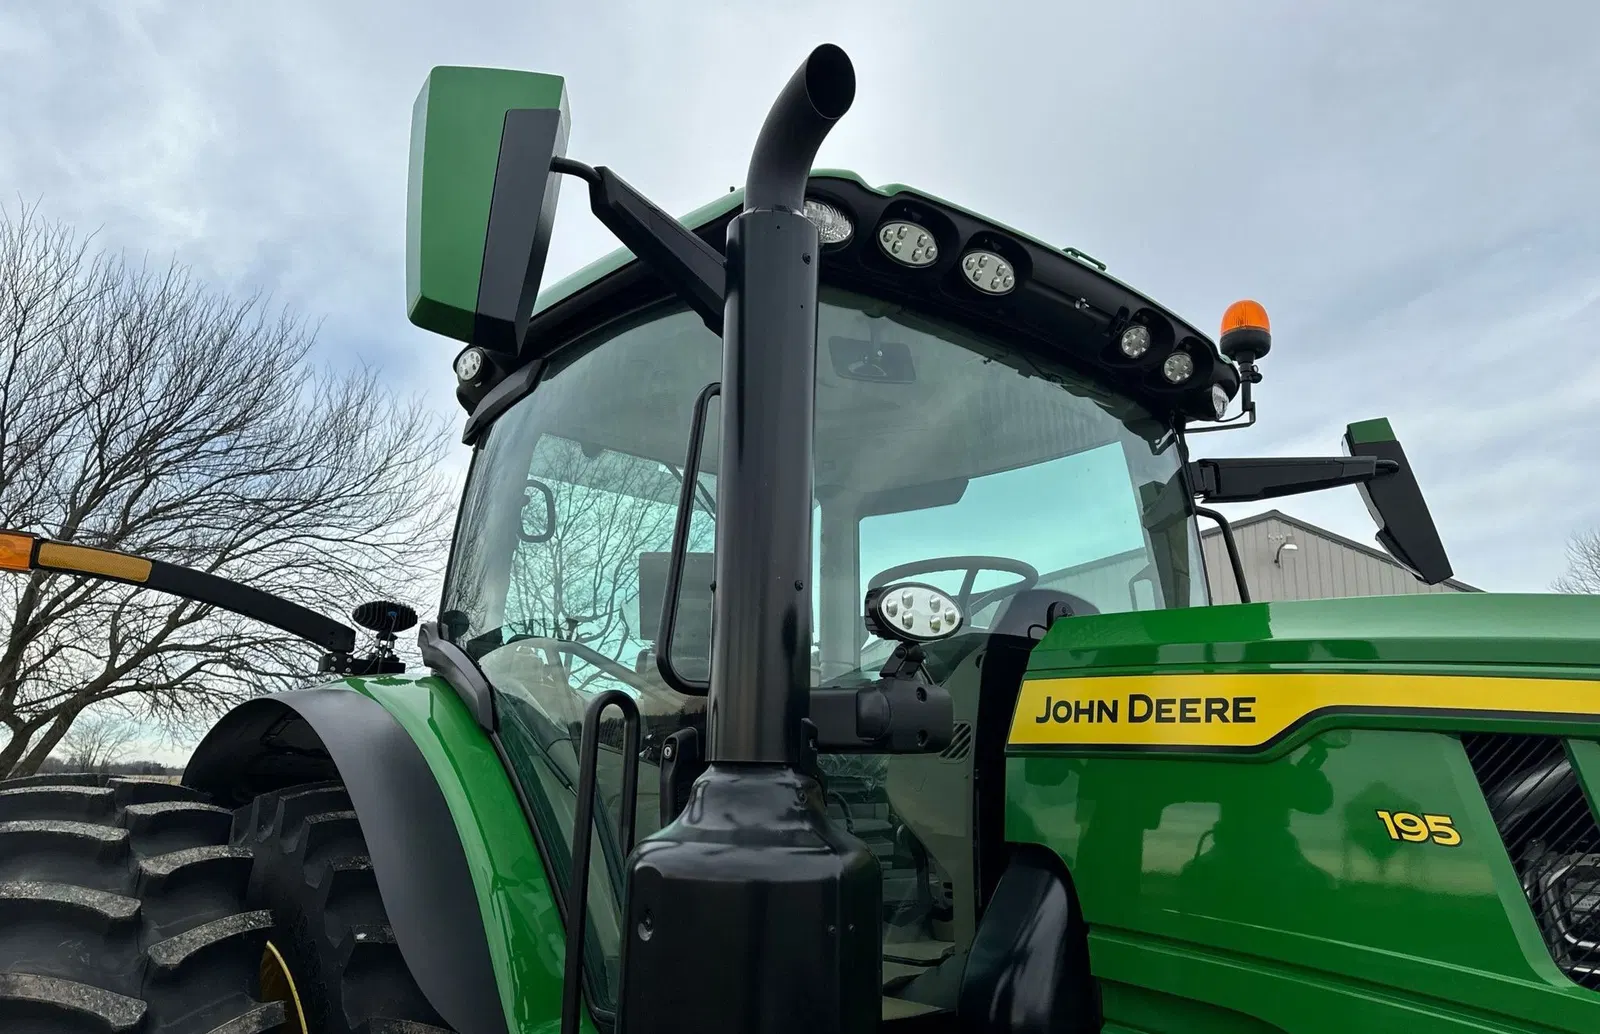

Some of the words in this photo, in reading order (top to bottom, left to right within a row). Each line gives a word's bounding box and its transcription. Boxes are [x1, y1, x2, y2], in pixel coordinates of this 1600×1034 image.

[1036, 696, 1118, 723] JOHN
[1128, 693, 1256, 723] DEERE
[1376, 809, 1462, 847] 195
